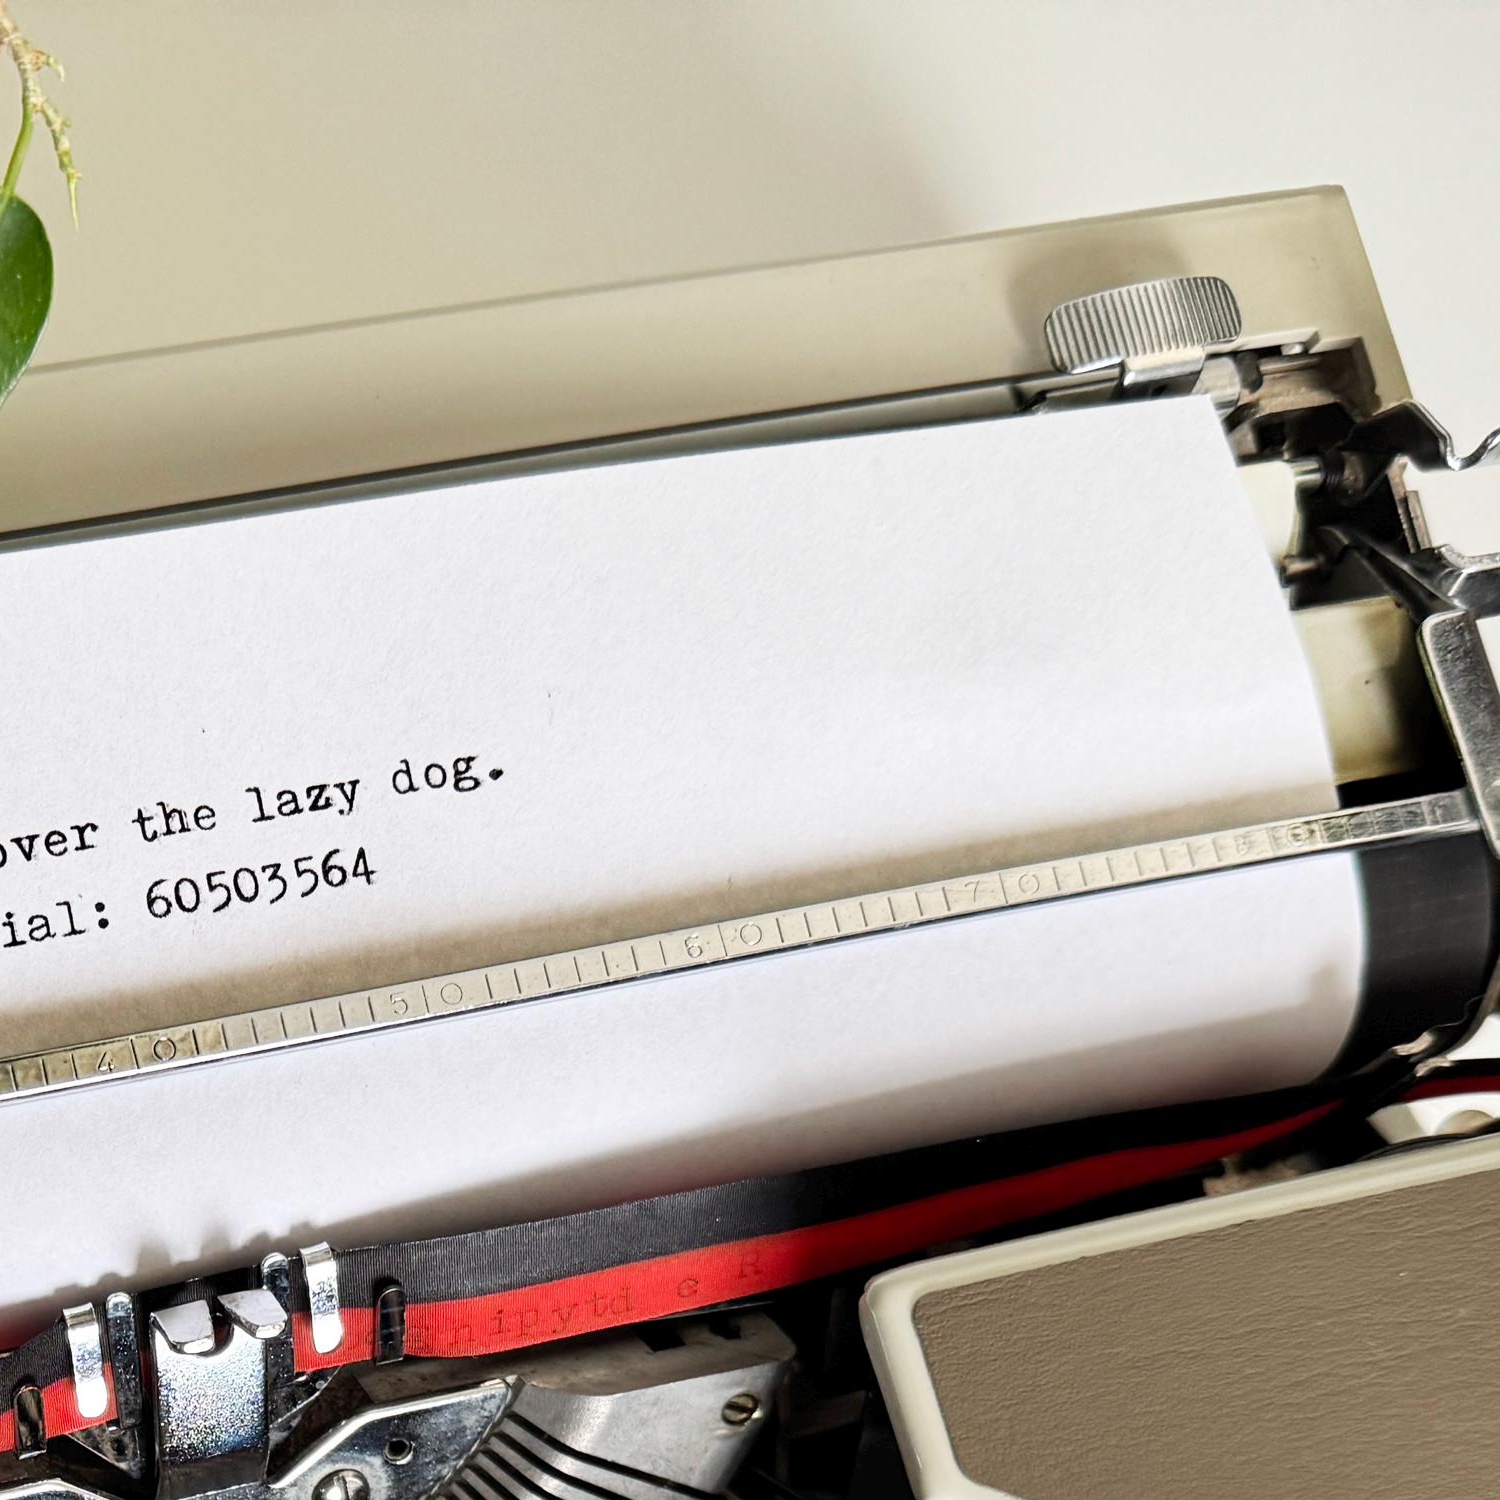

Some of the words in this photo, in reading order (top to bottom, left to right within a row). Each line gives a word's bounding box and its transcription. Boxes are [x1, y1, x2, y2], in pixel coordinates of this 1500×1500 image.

[132, 801, 216, 842] the
[245, 779, 360, 823] lazy
[392, 756, 503, 794] dog.
[147, 847, 377, 919] 60503564
